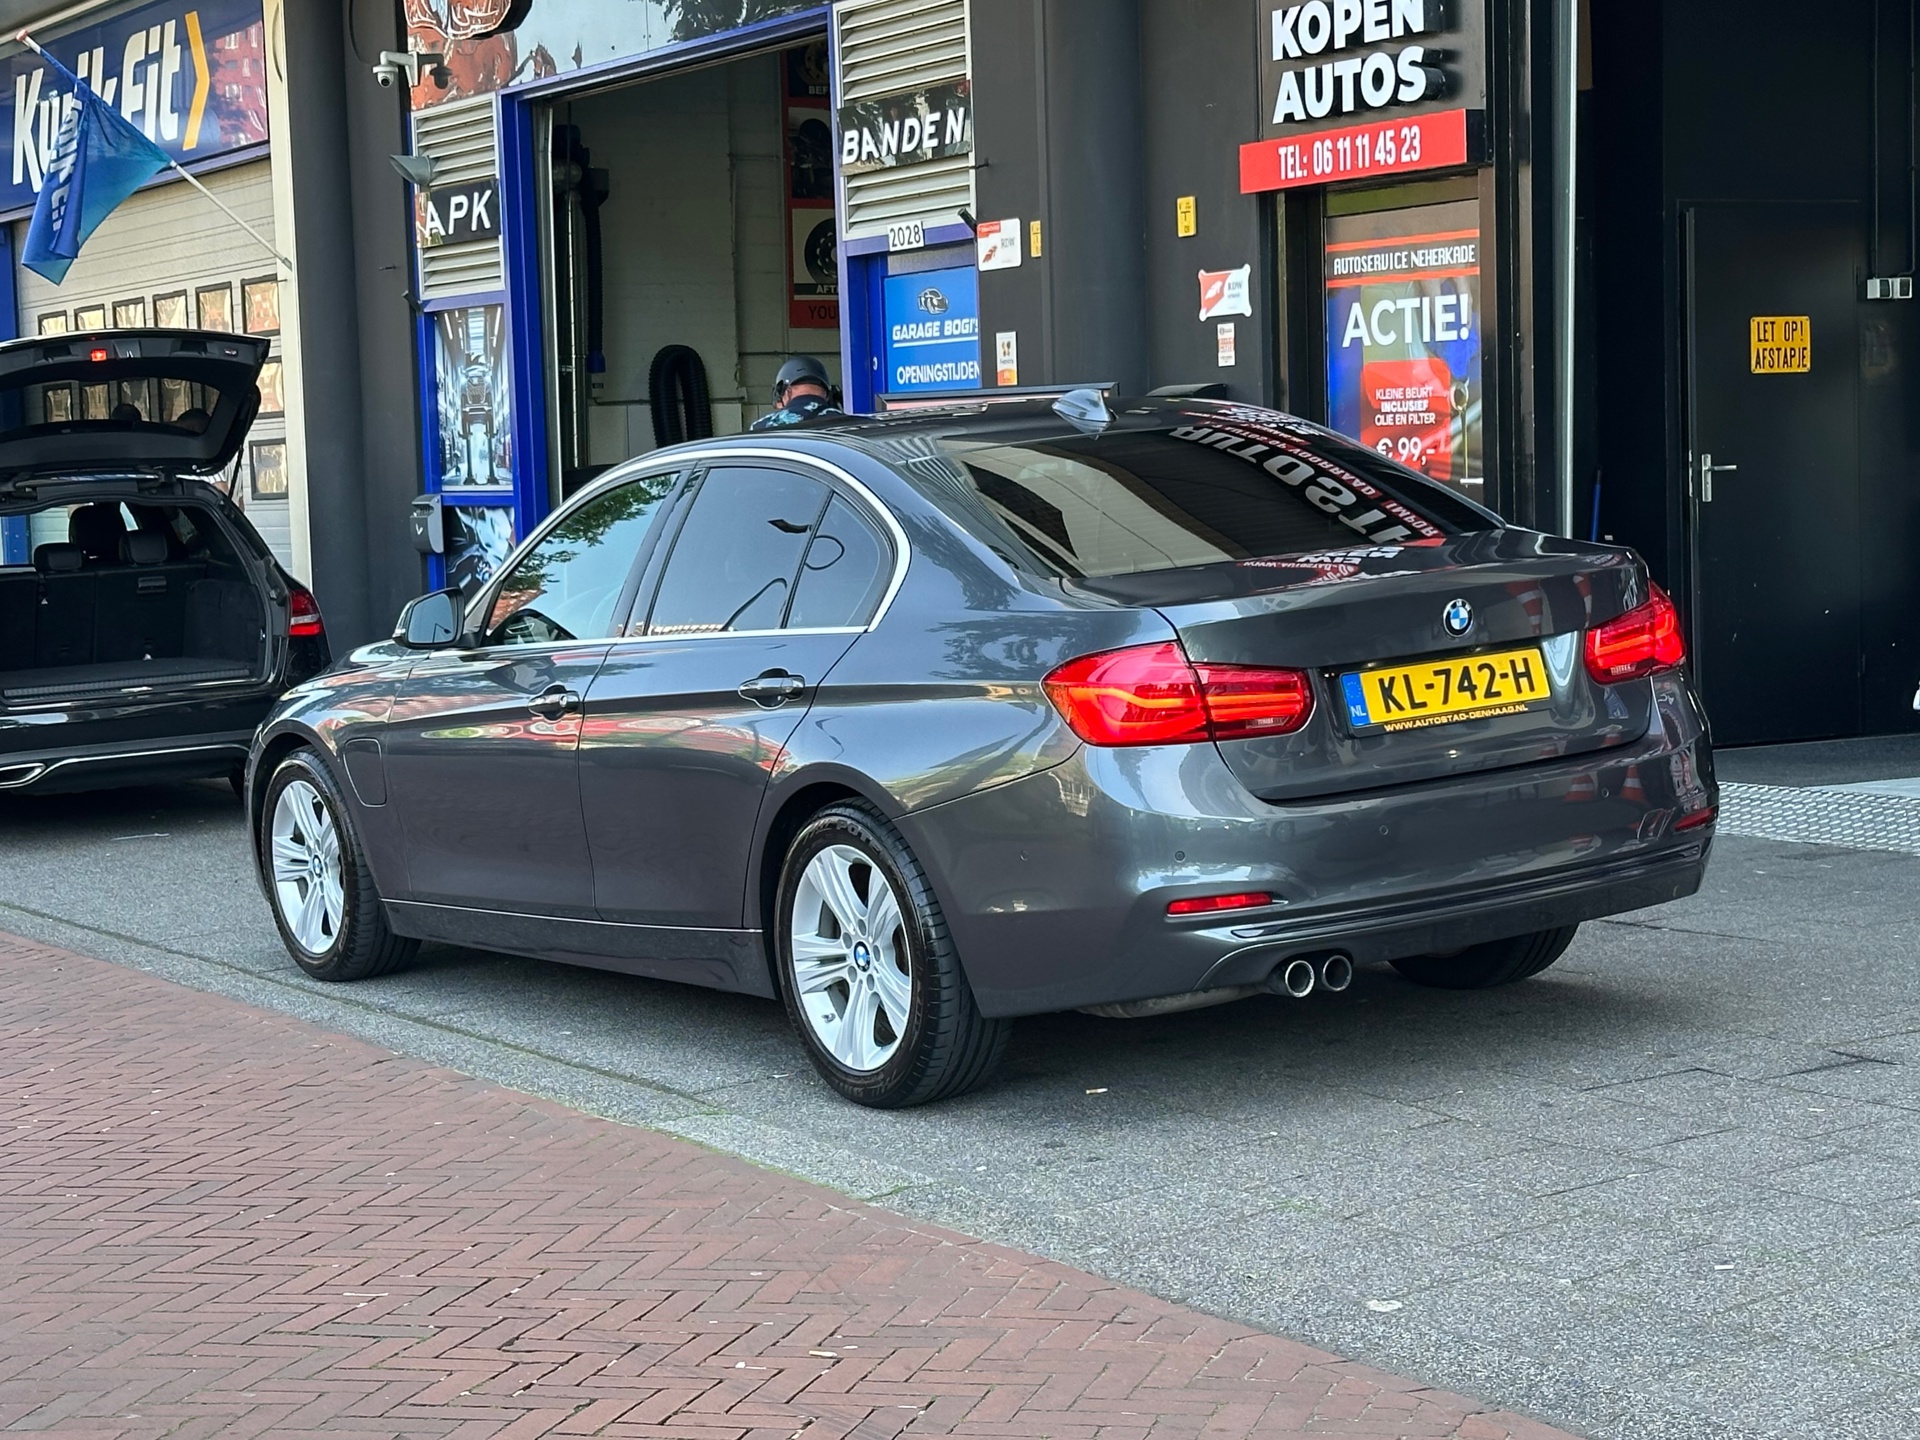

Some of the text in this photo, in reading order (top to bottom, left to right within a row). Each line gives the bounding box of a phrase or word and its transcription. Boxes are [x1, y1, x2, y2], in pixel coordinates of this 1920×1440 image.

[1271, 0, 1425, 61] KOPEN
[1272, 46, 1427, 124] AUTOS
[842, 107, 965, 165] BANDEN
[1278, 125, 1421, 180] TEL: 06 11 11 45 23
[425, 189, 492, 236] APK
[889, 224, 922, 248] 2028
[1333, 244, 1476, 275] AUTOSERVICE NEHERKADE
[892, 321, 941, 340] GARAGE
[1342, 294, 1470, 348] ACTIE!
[1756, 320, 1804, 342] LET OP!
[1755, 347, 1807, 369] AFSTAPJE
[896, 360, 980, 385] OPENINGSTIJDEN
[1375, 385, 1433, 400] KLEINE BEURT
[1381, 399, 1429, 412] INCLUSIEF
[1375, 412, 1436, 426] OLIE EN FILTER
[1377, 656, 1536, 714] KL-742-H
[1351, 704, 1367, 718] NL
[1383, 703, 1529, 732] WWW.AUTOSTAD-DENHAAG.NL
